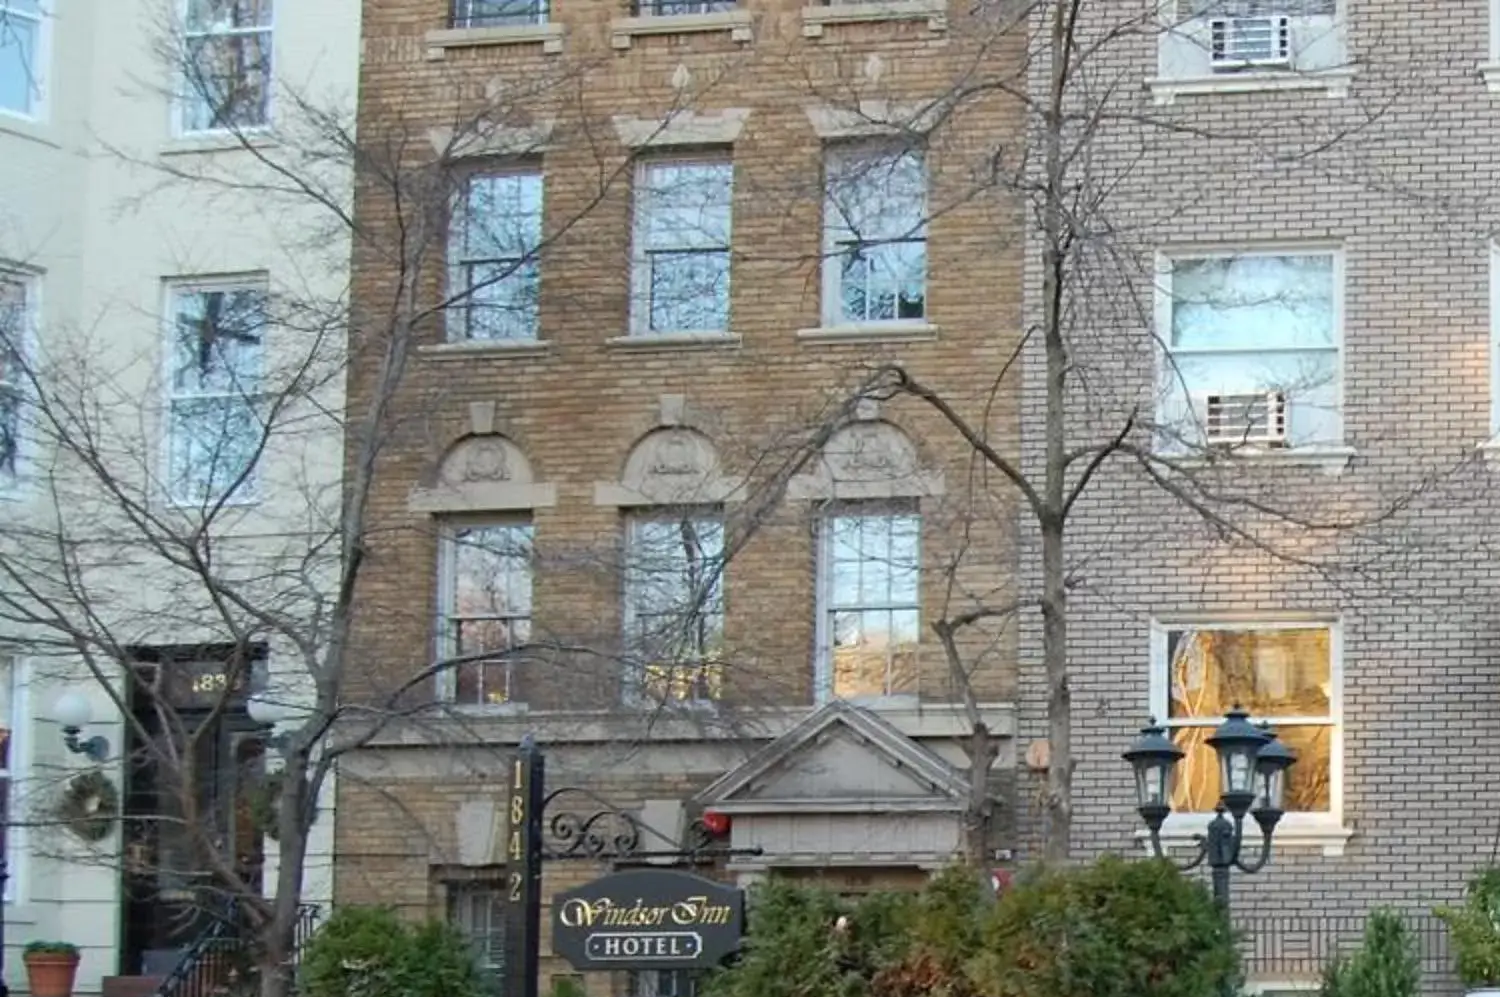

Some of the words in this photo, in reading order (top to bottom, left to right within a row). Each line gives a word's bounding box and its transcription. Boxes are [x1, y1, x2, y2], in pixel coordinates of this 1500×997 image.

[509, 760, 523, 901] 1842
[560, 898, 669, 927] Windsor
[671, 896, 731, 925] Inn
[604, 937, 681, 955] HOTEL
